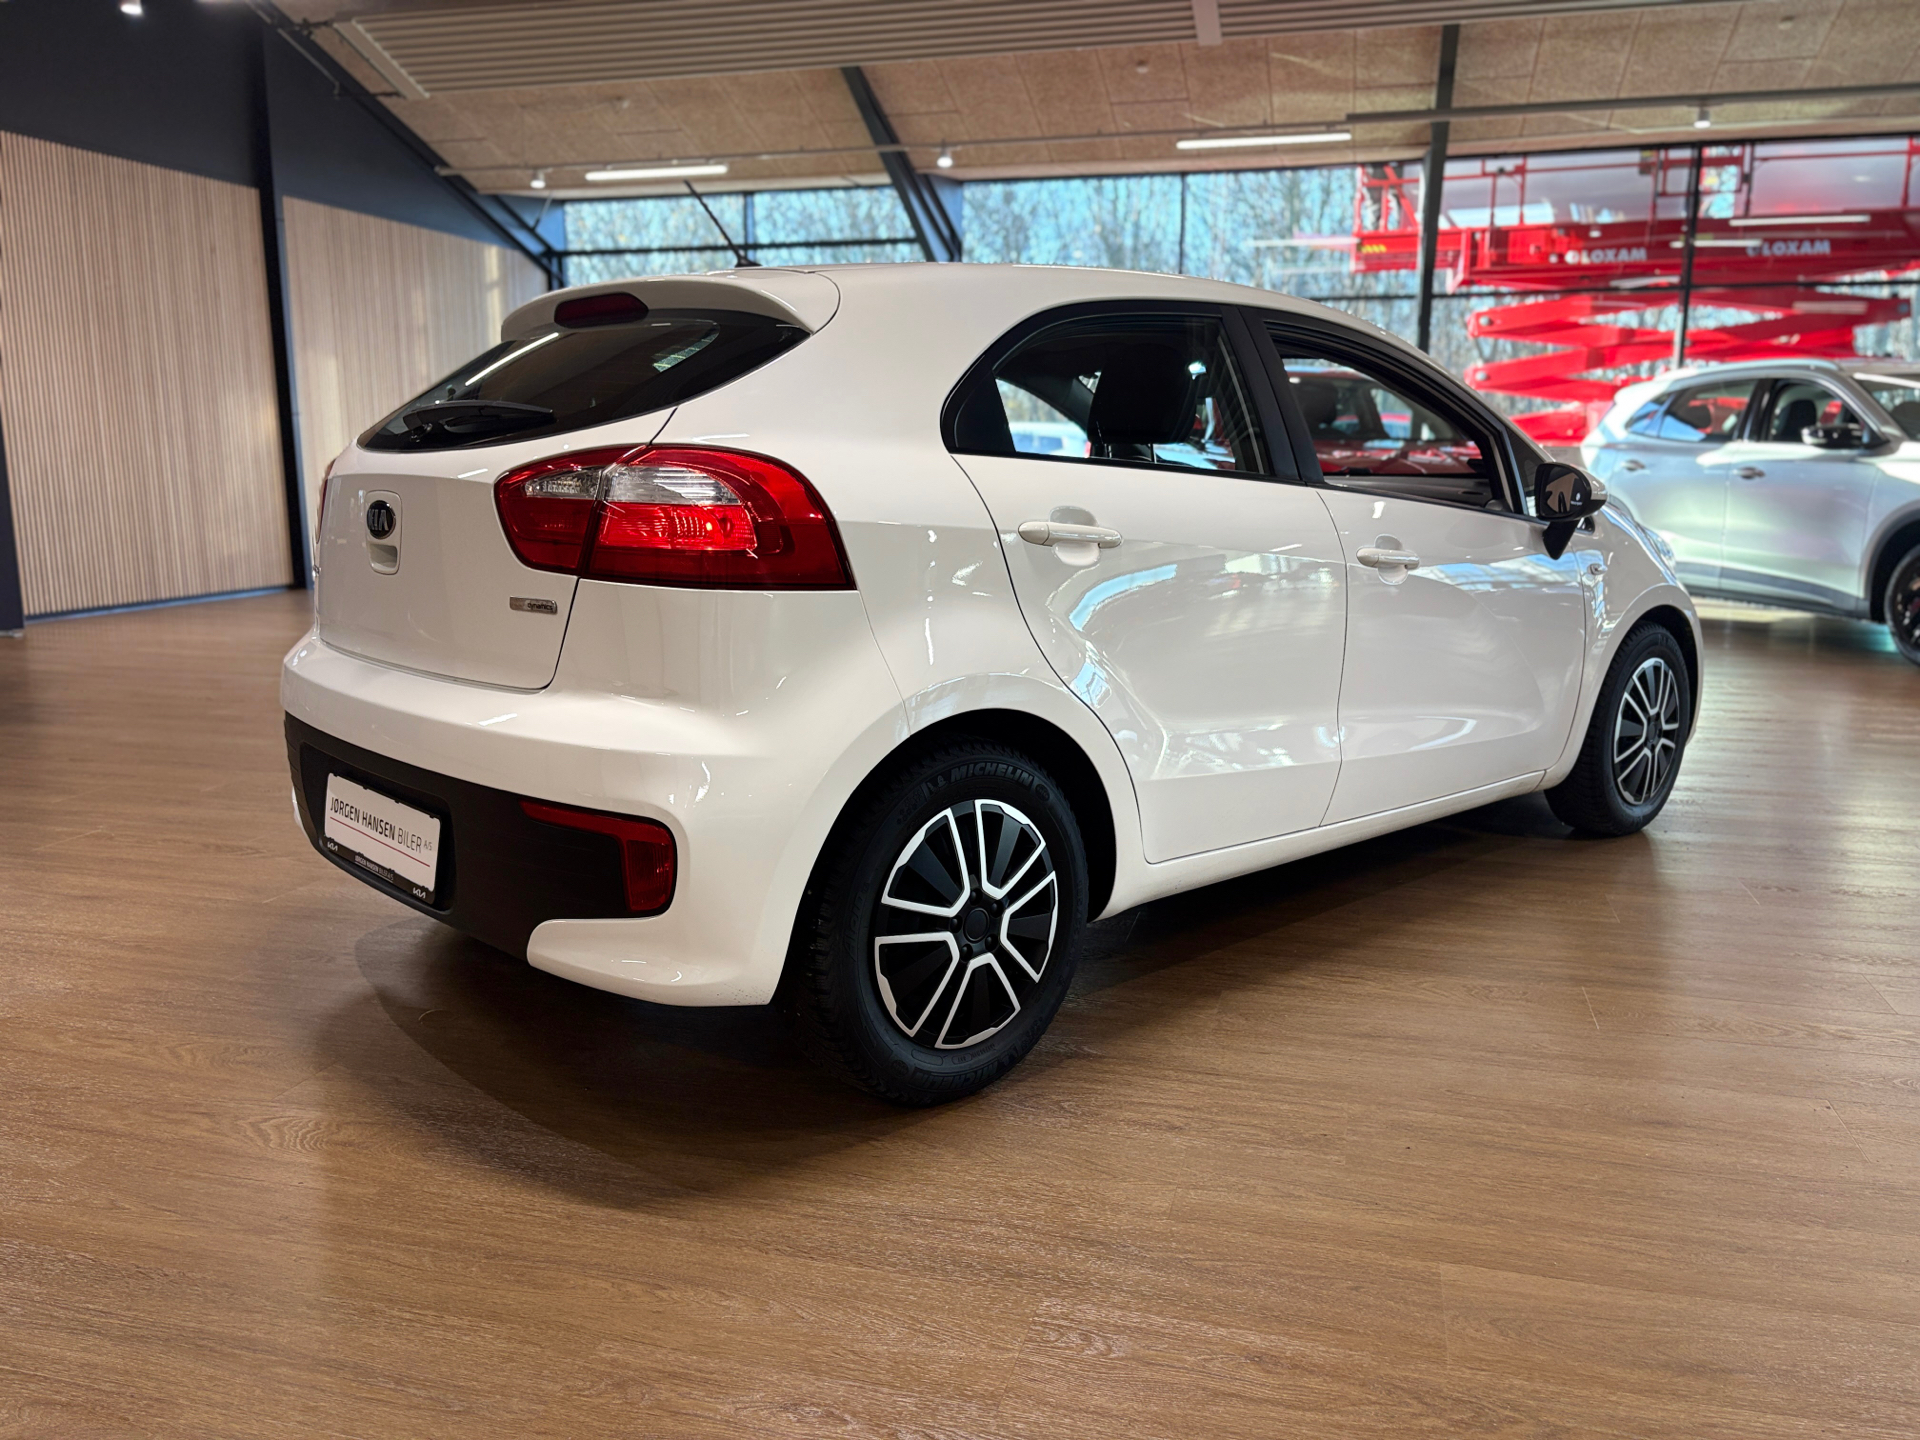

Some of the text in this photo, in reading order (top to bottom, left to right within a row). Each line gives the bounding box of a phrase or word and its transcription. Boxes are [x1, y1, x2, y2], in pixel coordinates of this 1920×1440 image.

[1580, 246, 1648, 265] LOXAM
[1762, 239, 1831, 256] LOXAM
[368, 508, 390, 531] KIA
[950, 762, 1034, 787] MICHELIN
[330, 797, 432, 853] JØRGEN HANSEN BILER A/S
[327, 842, 338, 852] KIA
[412, 887, 426, 898] KIA
